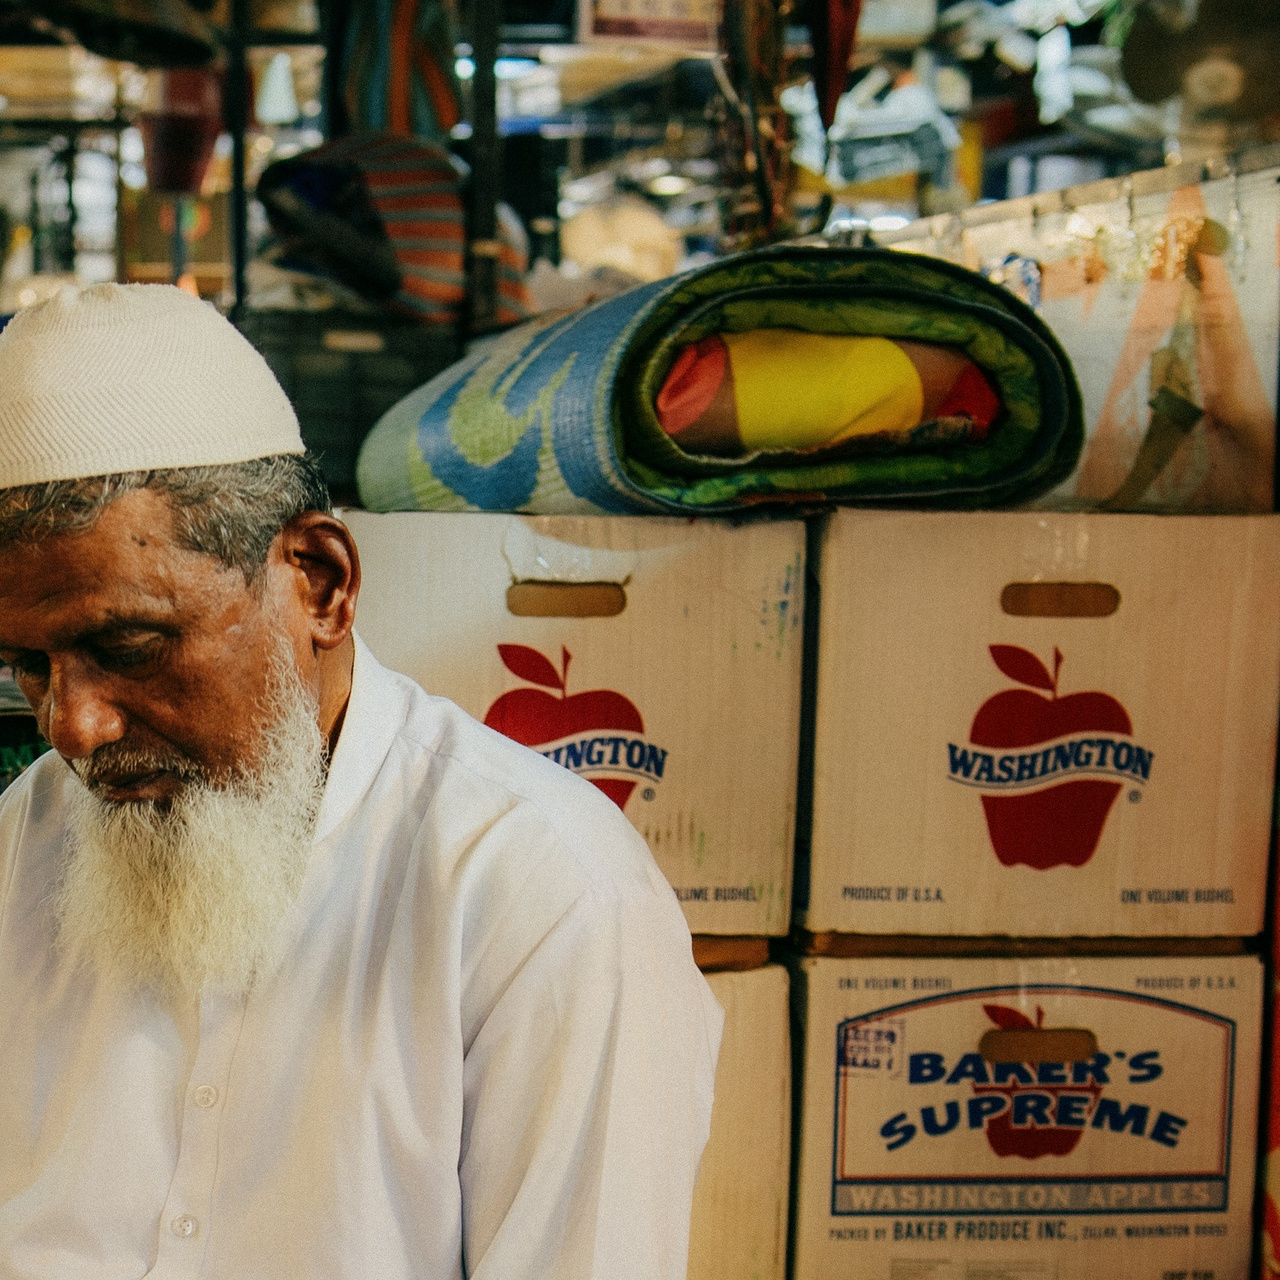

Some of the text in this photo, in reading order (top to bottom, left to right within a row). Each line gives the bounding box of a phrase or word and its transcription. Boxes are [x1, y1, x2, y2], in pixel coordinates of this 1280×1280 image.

[947, 738, 1154, 780] WASHINGTON
[842, 886, 891, 901] PRODUCE
[896, 887, 908, 901] OF
[909, 1050, 1164, 1085] BAKER'S
[880, 1093, 1188, 1151] SUPREME
[847, 1182, 1210, 1210] WASHINGTON APPLES
[830, 1228, 871, 1241] PACKED
[876, 1228, 887, 1241] BY
[893, 1222, 947, 1241] BAKER
[954, 1222, 1029, 1241] PRODUCE
